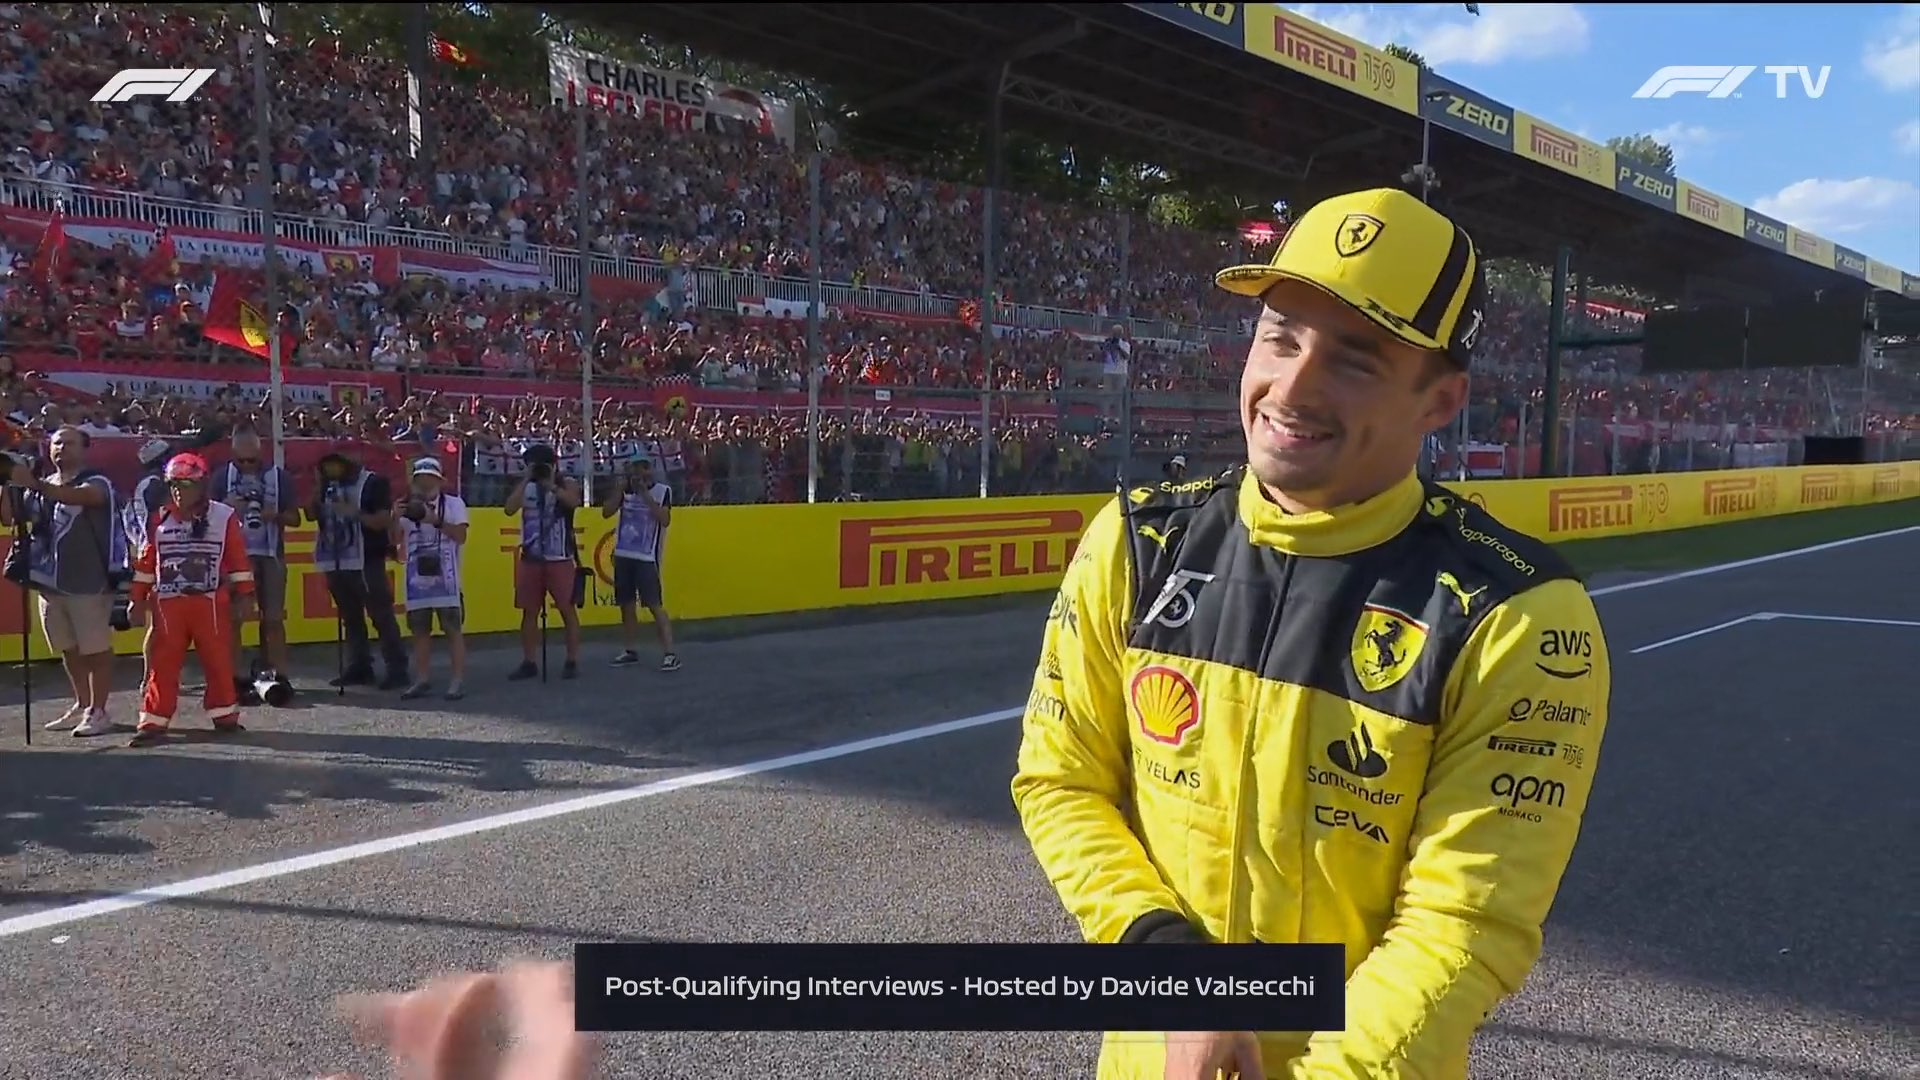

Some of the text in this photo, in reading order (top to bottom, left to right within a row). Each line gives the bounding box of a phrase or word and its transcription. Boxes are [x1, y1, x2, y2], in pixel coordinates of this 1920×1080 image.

[1274, 15, 1357, 82] PIRELLI
[585, 58, 706, 108] CHARLES
[1446, 95, 1509, 136] ZERO
[1530, 124, 1578, 168] PIRELLI
[1618, 166, 1674, 199] P ZERO
[1160, 476, 1217, 494] Snapd
[1704, 476, 1757, 516] PIRELLI
[1548, 485, 1633, 532] PIRELLI
[1540, 629, 1592, 658] aws
[1487, 735, 1557, 757] PIRELLI
[1307, 764, 1405, 805] Santander
[1490, 773, 1565, 808] apm
